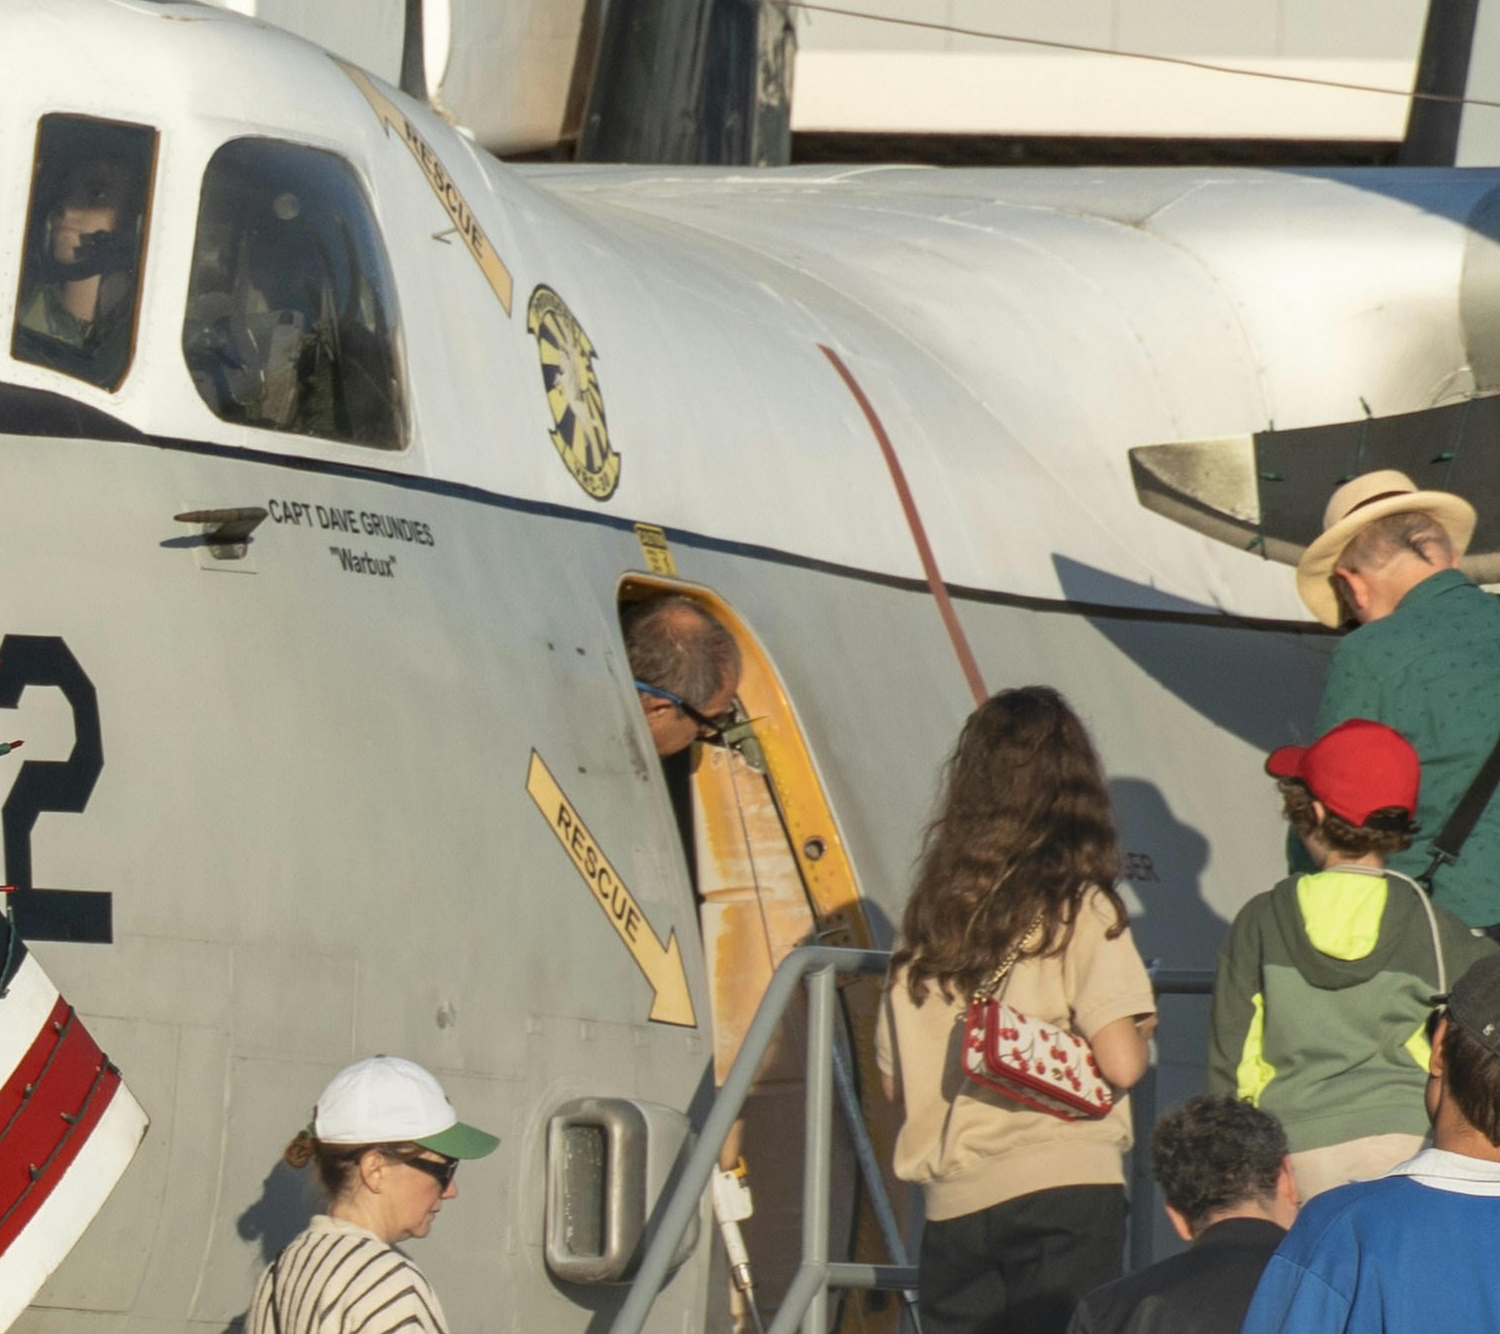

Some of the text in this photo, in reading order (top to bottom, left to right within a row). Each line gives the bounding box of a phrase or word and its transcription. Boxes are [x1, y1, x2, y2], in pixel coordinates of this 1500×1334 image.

[404, 120, 483, 259] RESCUE
[268, 499, 435, 547] CAPT DAVE GRUNDIES
[557, 802, 641, 944] RESCUE
